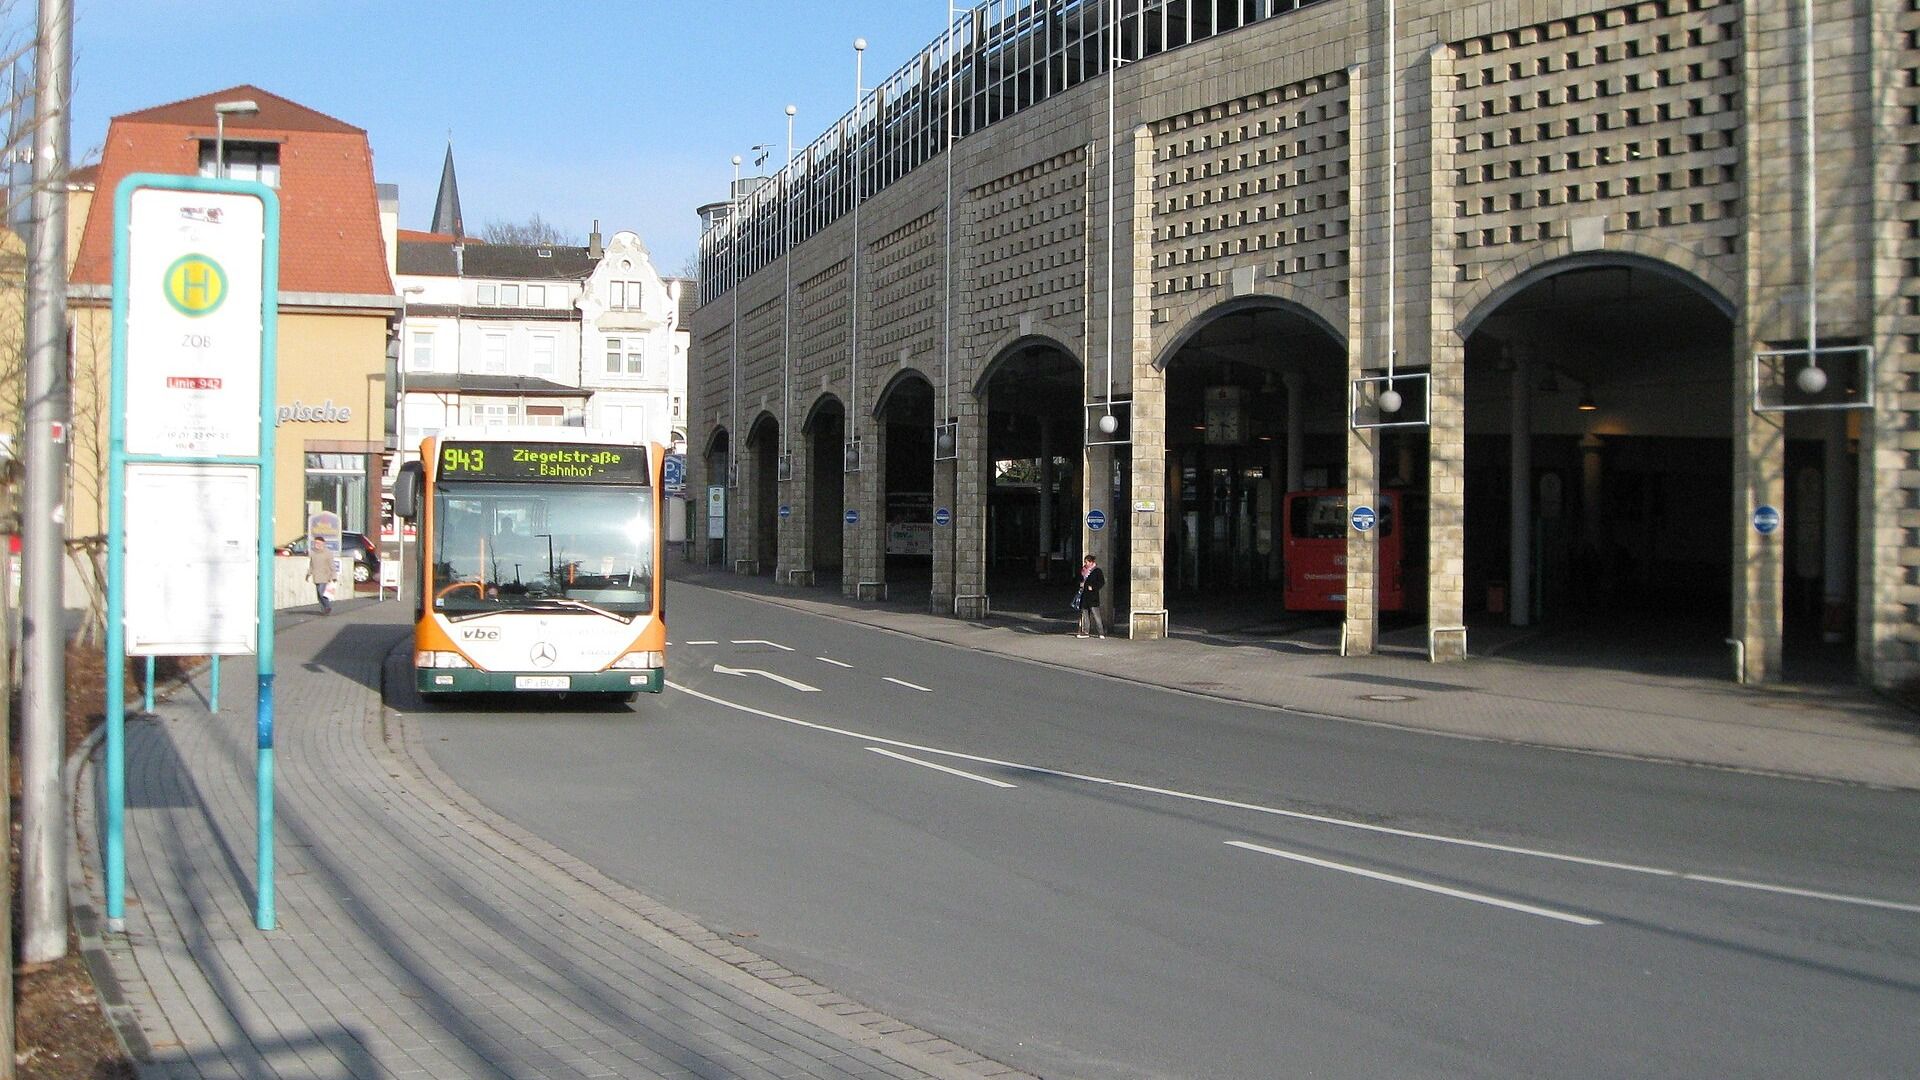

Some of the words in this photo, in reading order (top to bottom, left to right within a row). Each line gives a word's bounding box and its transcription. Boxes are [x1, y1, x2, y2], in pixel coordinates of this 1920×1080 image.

[183, 269, 209, 302] H
[182, 335, 211, 348] ZOB
[169, 379, 196, 389] Linie
[199, 380, 220, 390] 942
[277, 401, 351, 427] pische
[444, 449, 484, 471] 943
[513, 449, 621, 465] Ziegelstraße
[540, 464, 593, 477] Bahnhof
[464, 629, 498, 640] vbe
